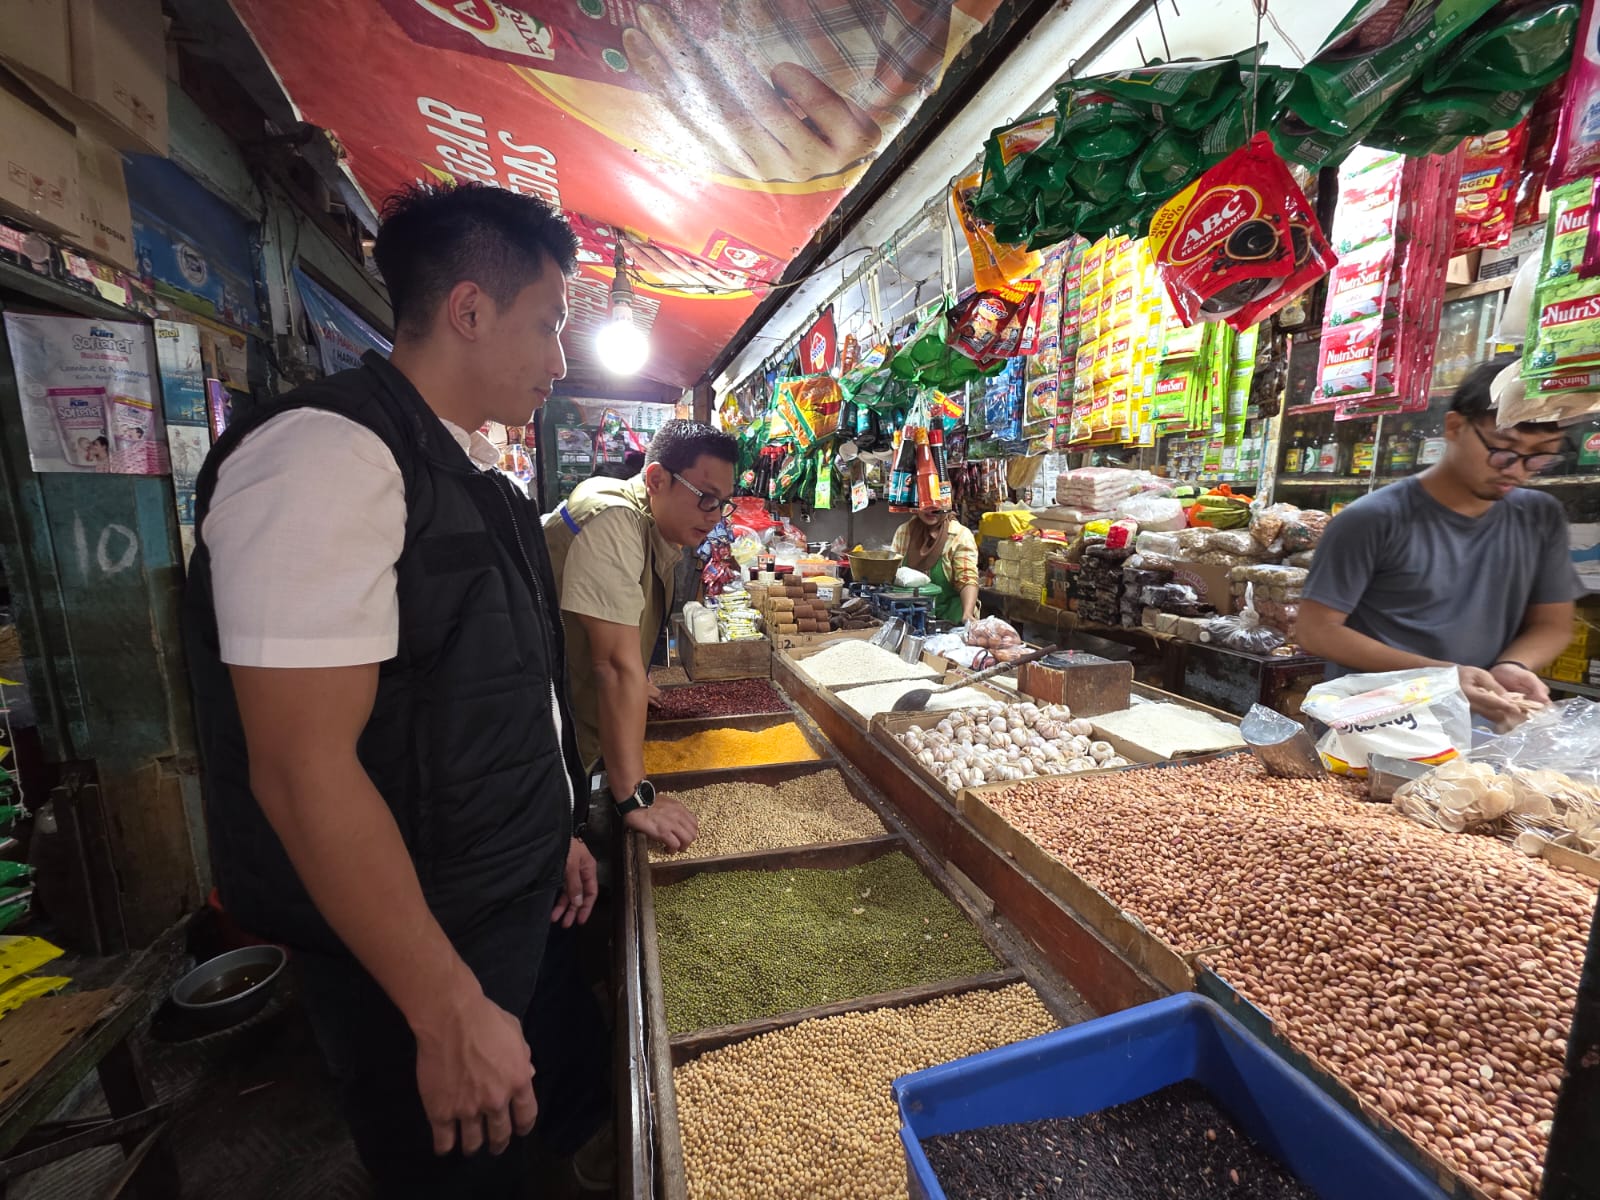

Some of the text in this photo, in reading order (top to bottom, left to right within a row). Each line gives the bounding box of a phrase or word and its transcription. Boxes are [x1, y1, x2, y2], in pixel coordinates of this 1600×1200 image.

[416, 96, 502, 189] EGAR
[498, 130, 563, 211] EDAS
[1459, 177, 1492, 191] RGEN
[1155, 205, 1185, 238] 30%
[1181, 194, 1242, 250] ABC
[1181, 209, 1248, 257] KECAP MANIS
[1547, 297, 1600, 324] NutriS
[1327, 345, 1369, 364] NutriSari
[1544, 376, 1588, 388] NutriSa
[73, 509, 138, 588] 10
[1050, 578, 1070, 592] TOP
